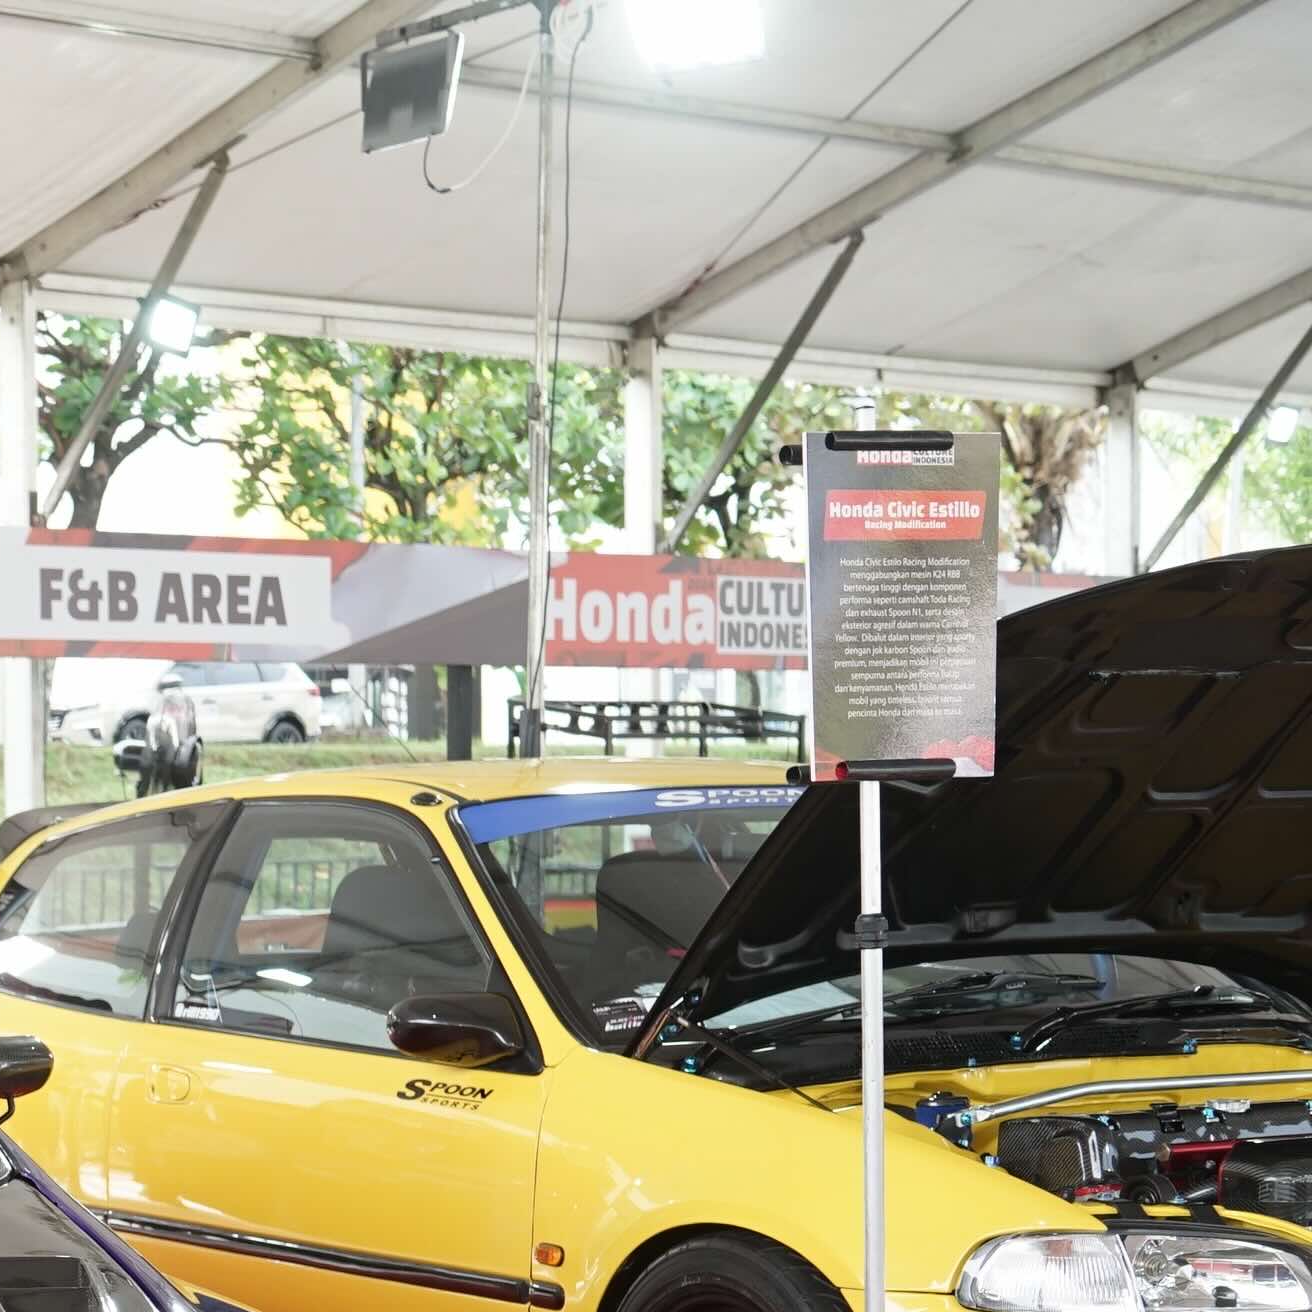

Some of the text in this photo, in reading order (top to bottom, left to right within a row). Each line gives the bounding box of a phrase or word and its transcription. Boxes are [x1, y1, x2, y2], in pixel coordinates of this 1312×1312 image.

[857, 450, 912, 463] Honda
[913, 456, 953, 464] INDONESIA
[830, 502, 980, 518] Honda Civic Estillo
[895, 520, 946, 529] Modification
[840, 558, 864, 566] Honda
[903, 558, 926, 568] Racing
[928, 558, 970, 566] Modification
[39, 567, 288, 627] F&B AREA
[546, 577, 805, 646] Honda CULTU
[719, 620, 807, 649] INDONE
[396, 1078, 495, 1101] SPOON
[419, 1097, 481, 1112] SPORTS
